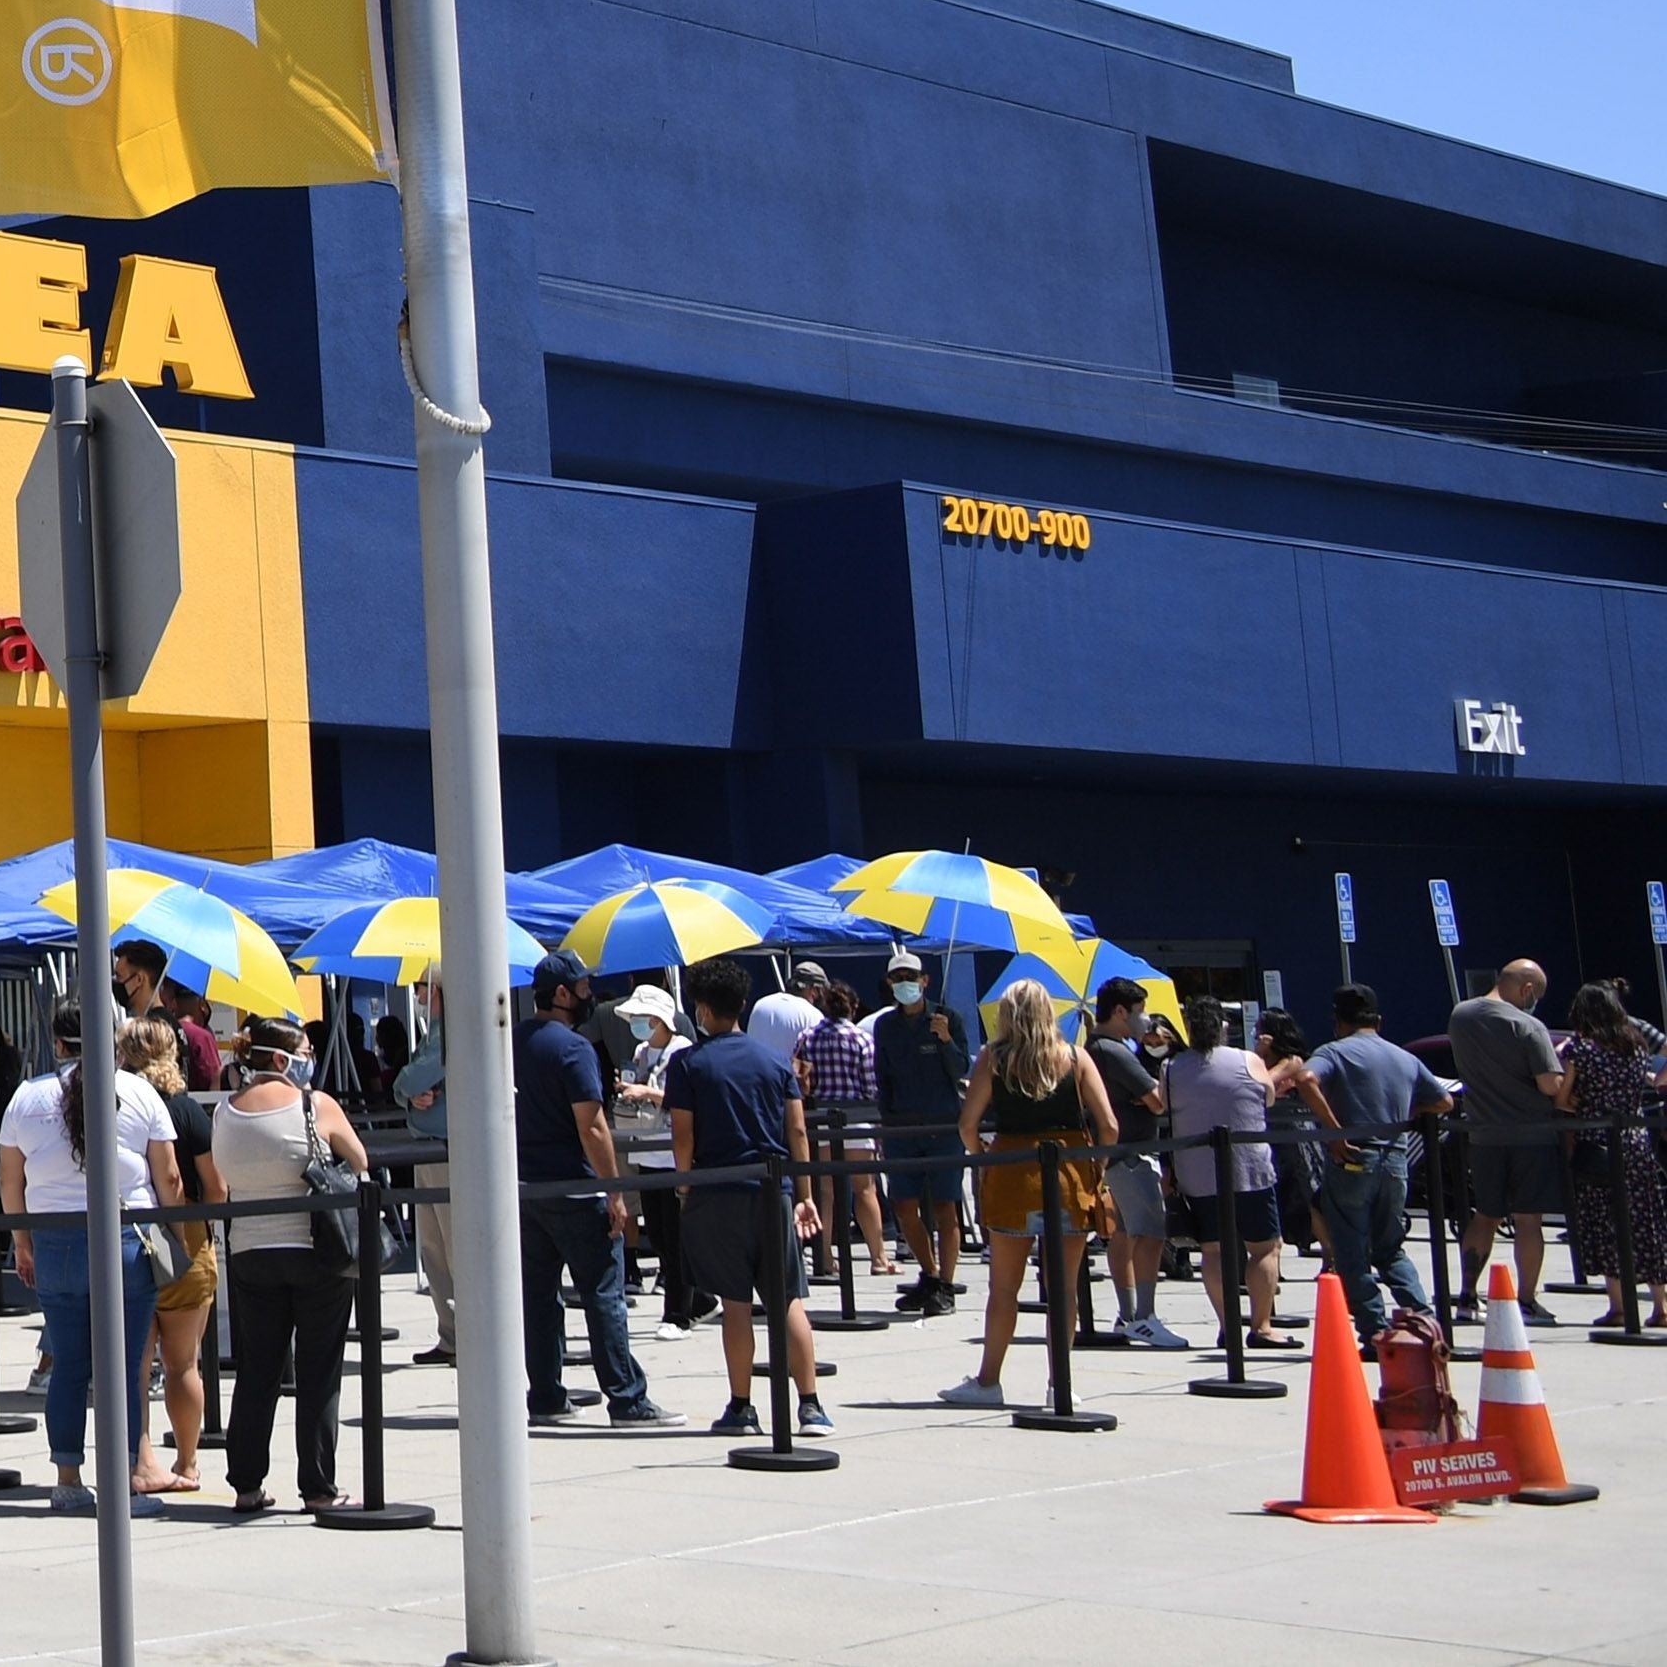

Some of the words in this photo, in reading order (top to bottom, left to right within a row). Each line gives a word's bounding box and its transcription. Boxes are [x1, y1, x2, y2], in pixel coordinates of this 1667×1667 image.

[942, 495, 1091, 550] 20700-900
[1455, 699, 1526, 755] Exit
[1404, 1478, 1434, 1492] 20700
[1447, 1472, 1483, 1487] AVALON
[1484, 1470, 1512, 1484] BLVD.
[1412, 1458, 1436, 1476] PIV
[1440, 1452, 1497, 1473] SERVES
